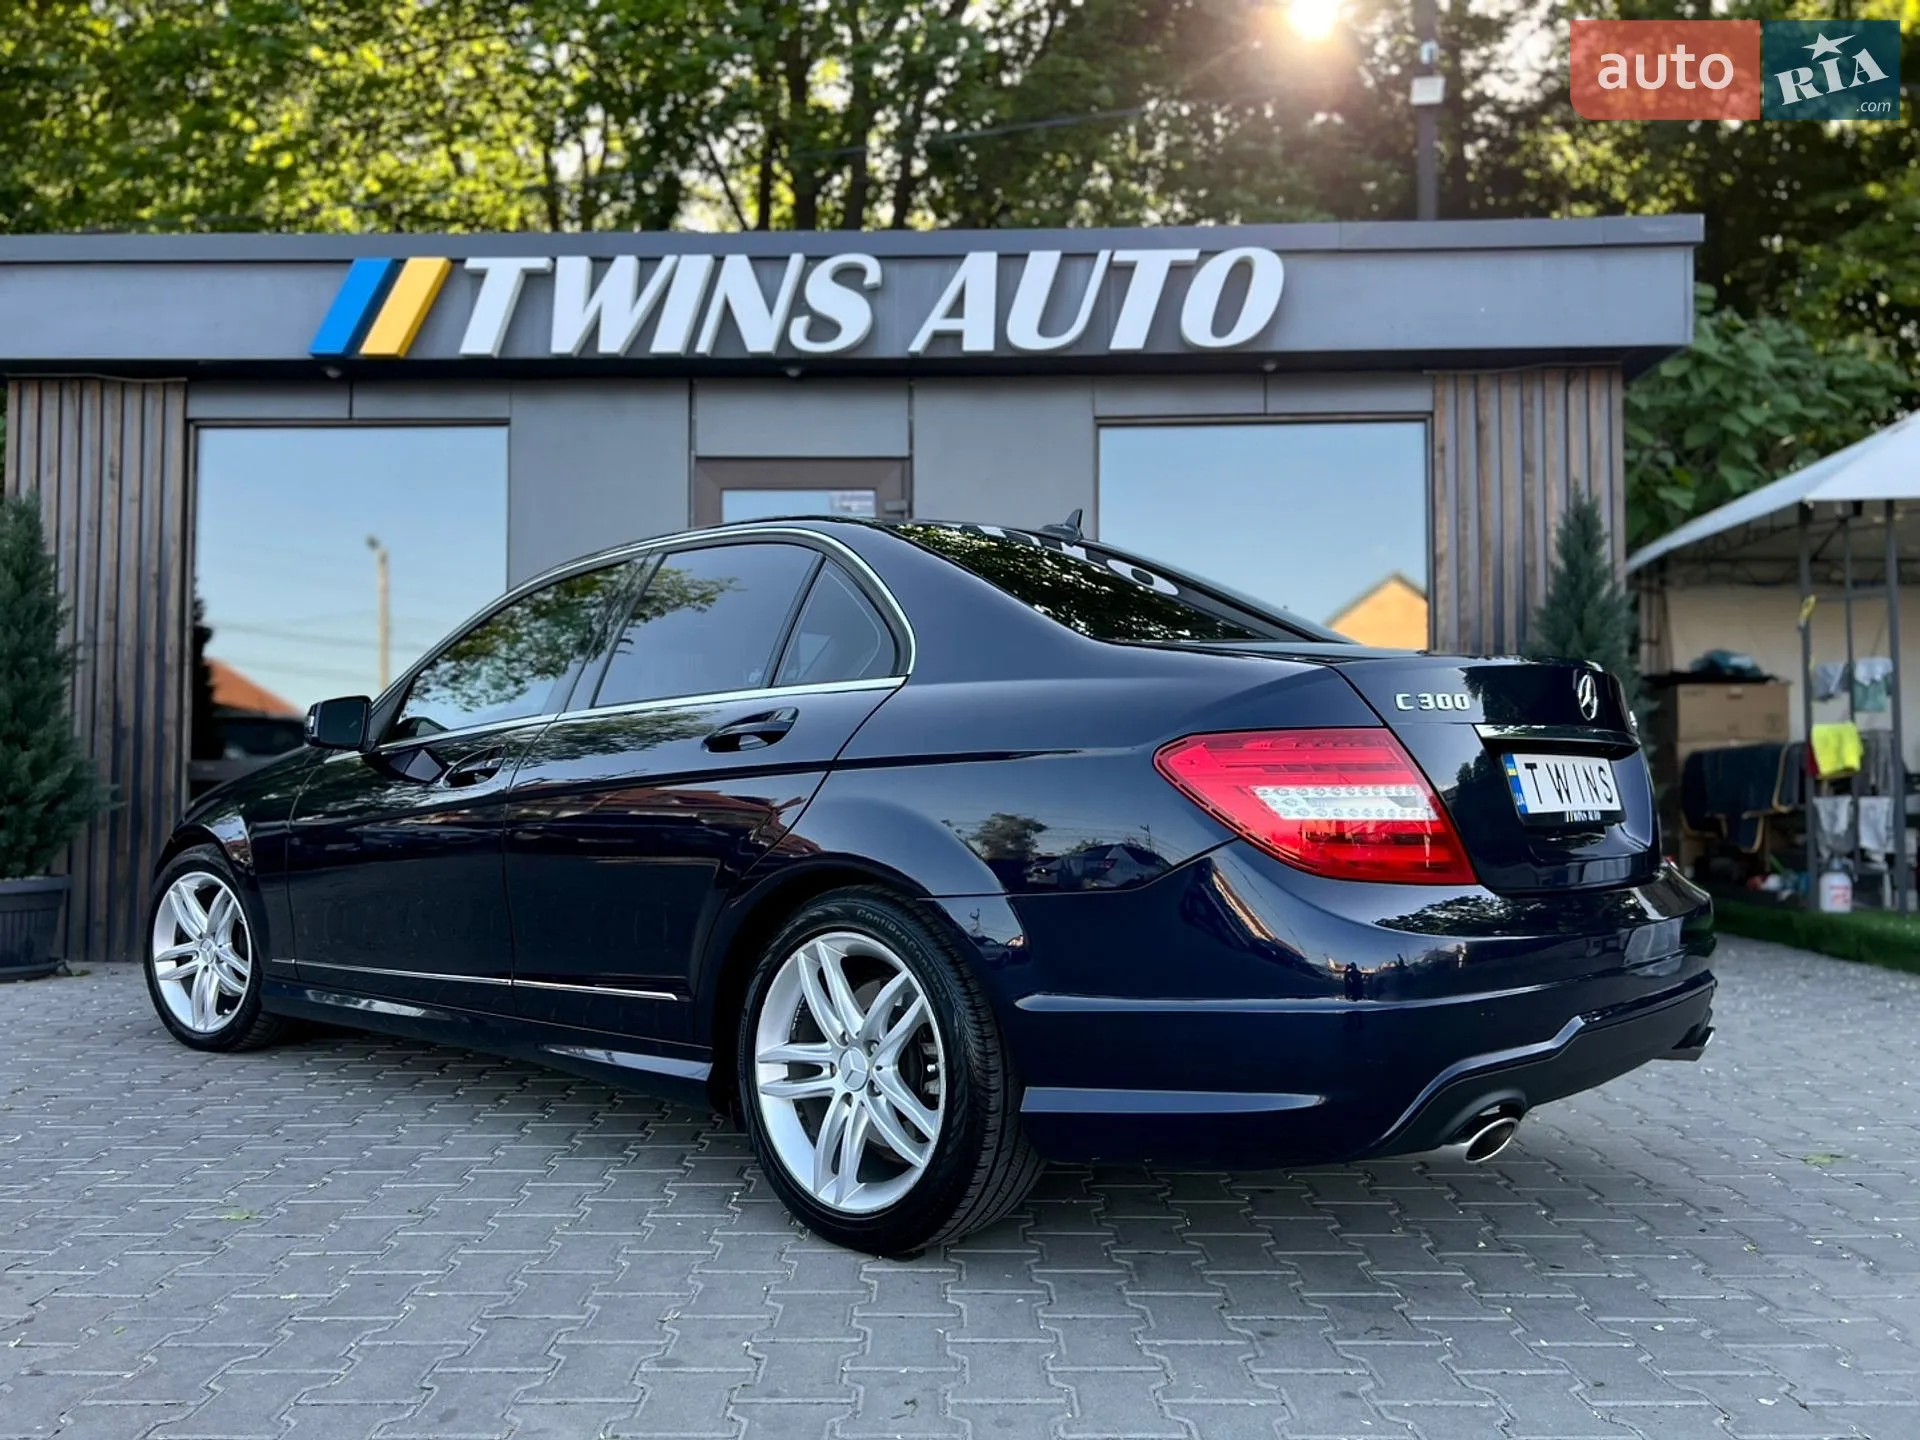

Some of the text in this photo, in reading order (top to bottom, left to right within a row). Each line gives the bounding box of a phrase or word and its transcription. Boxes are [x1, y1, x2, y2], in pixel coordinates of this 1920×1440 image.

[458, 246, 1286, 358] TWINS AUTO
[1394, 692, 1471, 711] C 300
